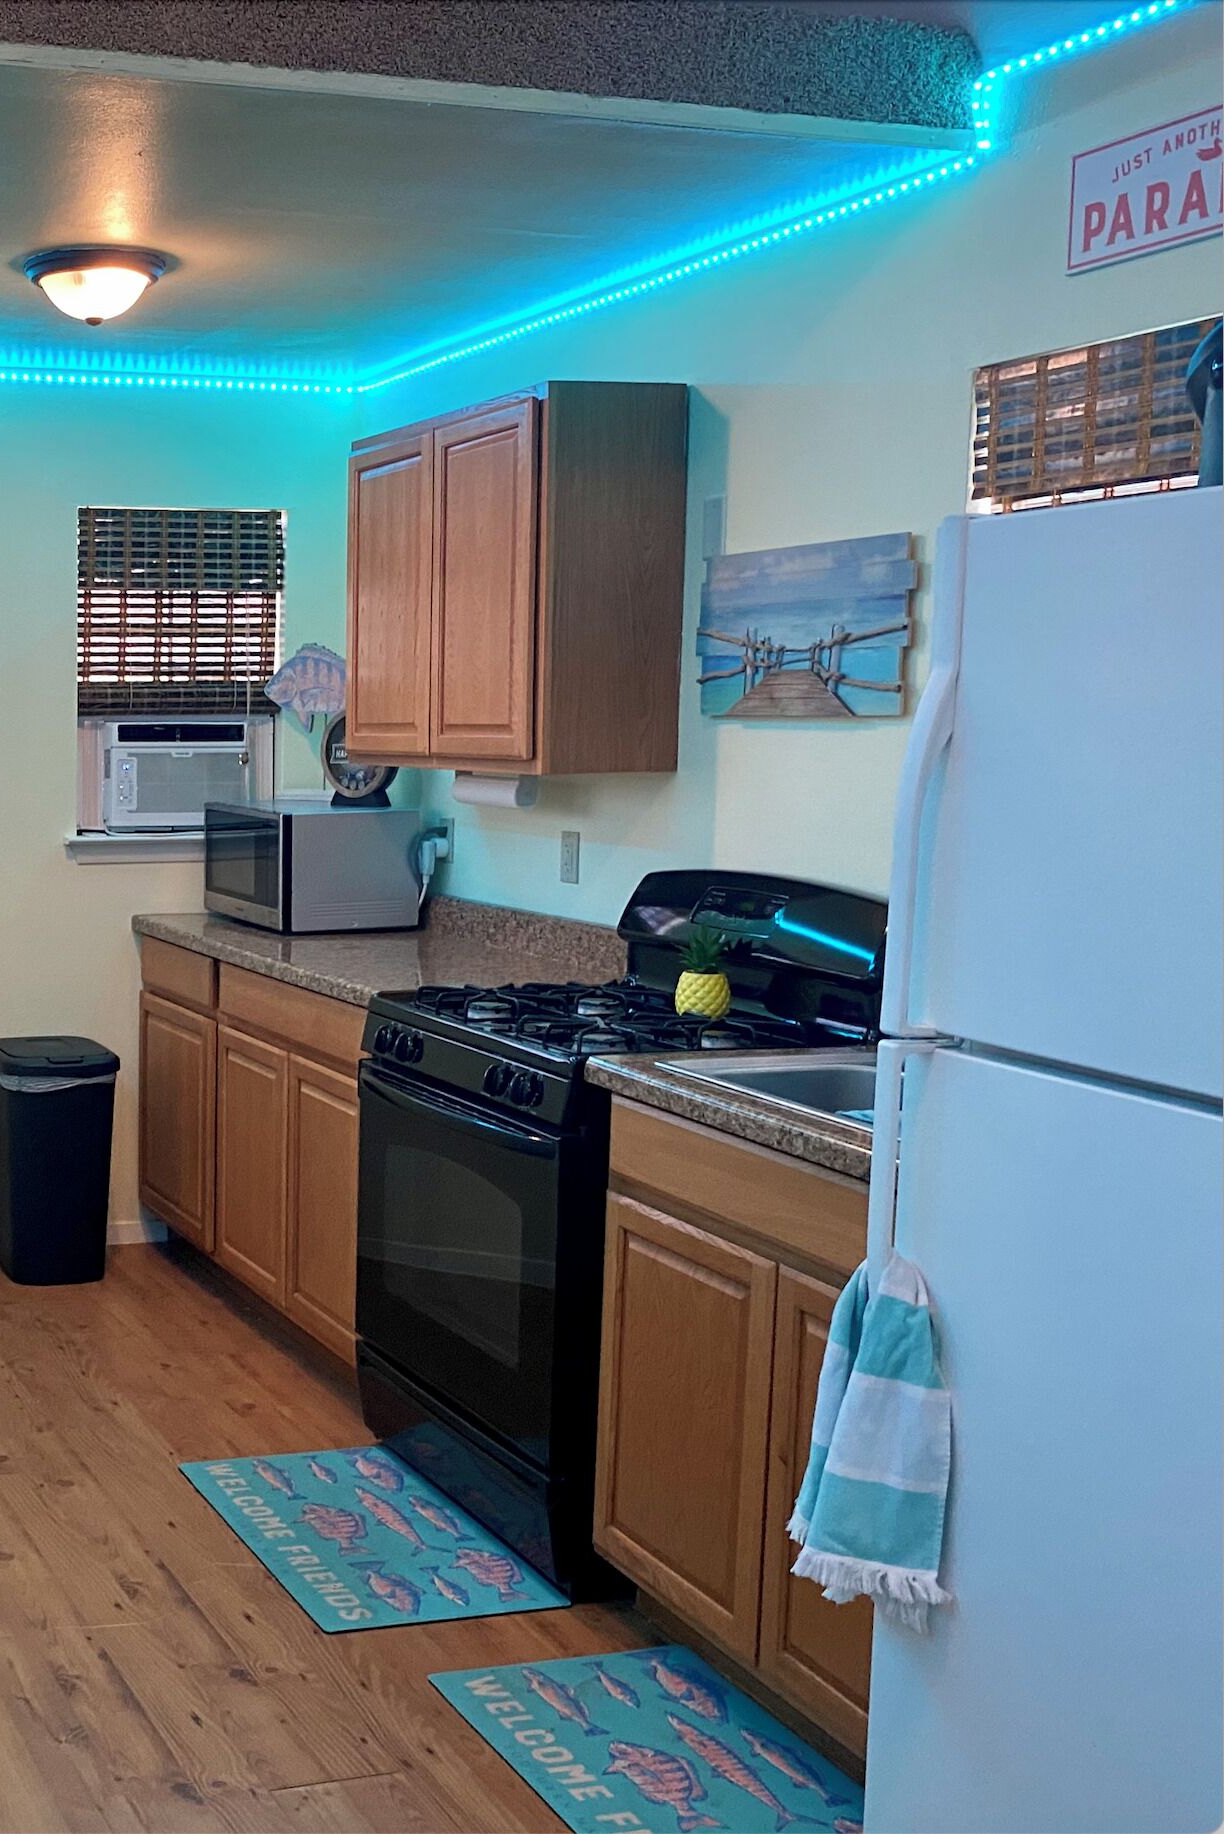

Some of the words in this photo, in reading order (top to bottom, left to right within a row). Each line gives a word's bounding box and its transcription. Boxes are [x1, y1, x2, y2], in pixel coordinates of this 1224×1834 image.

[1082, 160, 1223, 253] PARA
[1112, 147, 1153, 184] JUST
[205, 1463, 296, 1540] WELCOME
[278, 1544, 373, 1622] FRIENDS
[464, 1675, 615, 1802] WELCOME
[595, 1811, 654, 1834] F
